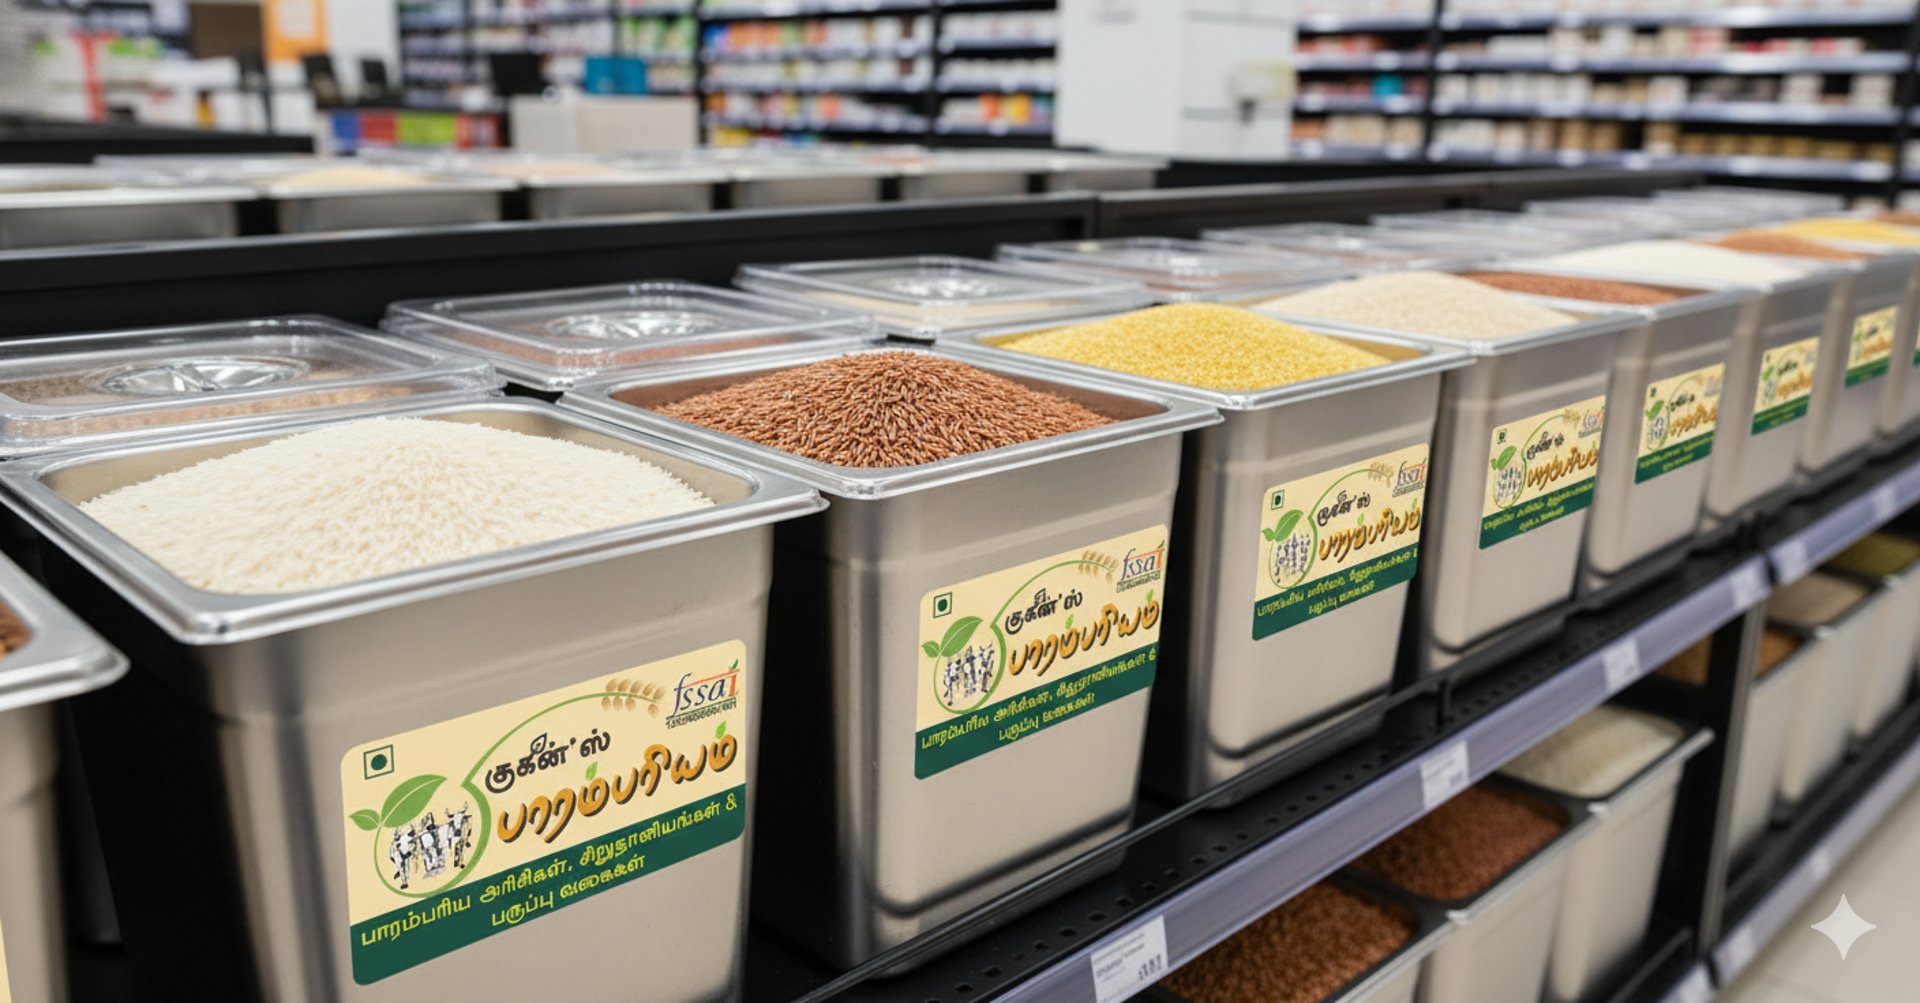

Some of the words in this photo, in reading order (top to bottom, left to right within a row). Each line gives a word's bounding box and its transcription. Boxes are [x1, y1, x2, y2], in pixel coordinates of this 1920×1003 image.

[1009, 589, 1159, 677] பாரம்பரியம்
[497, 721, 738, 843] பாரம்பரியம்
[361, 895, 471, 946] பாரம்பரிய
[725, 792, 738, 811] &
[491, 891, 553, 926] பருப்பு
